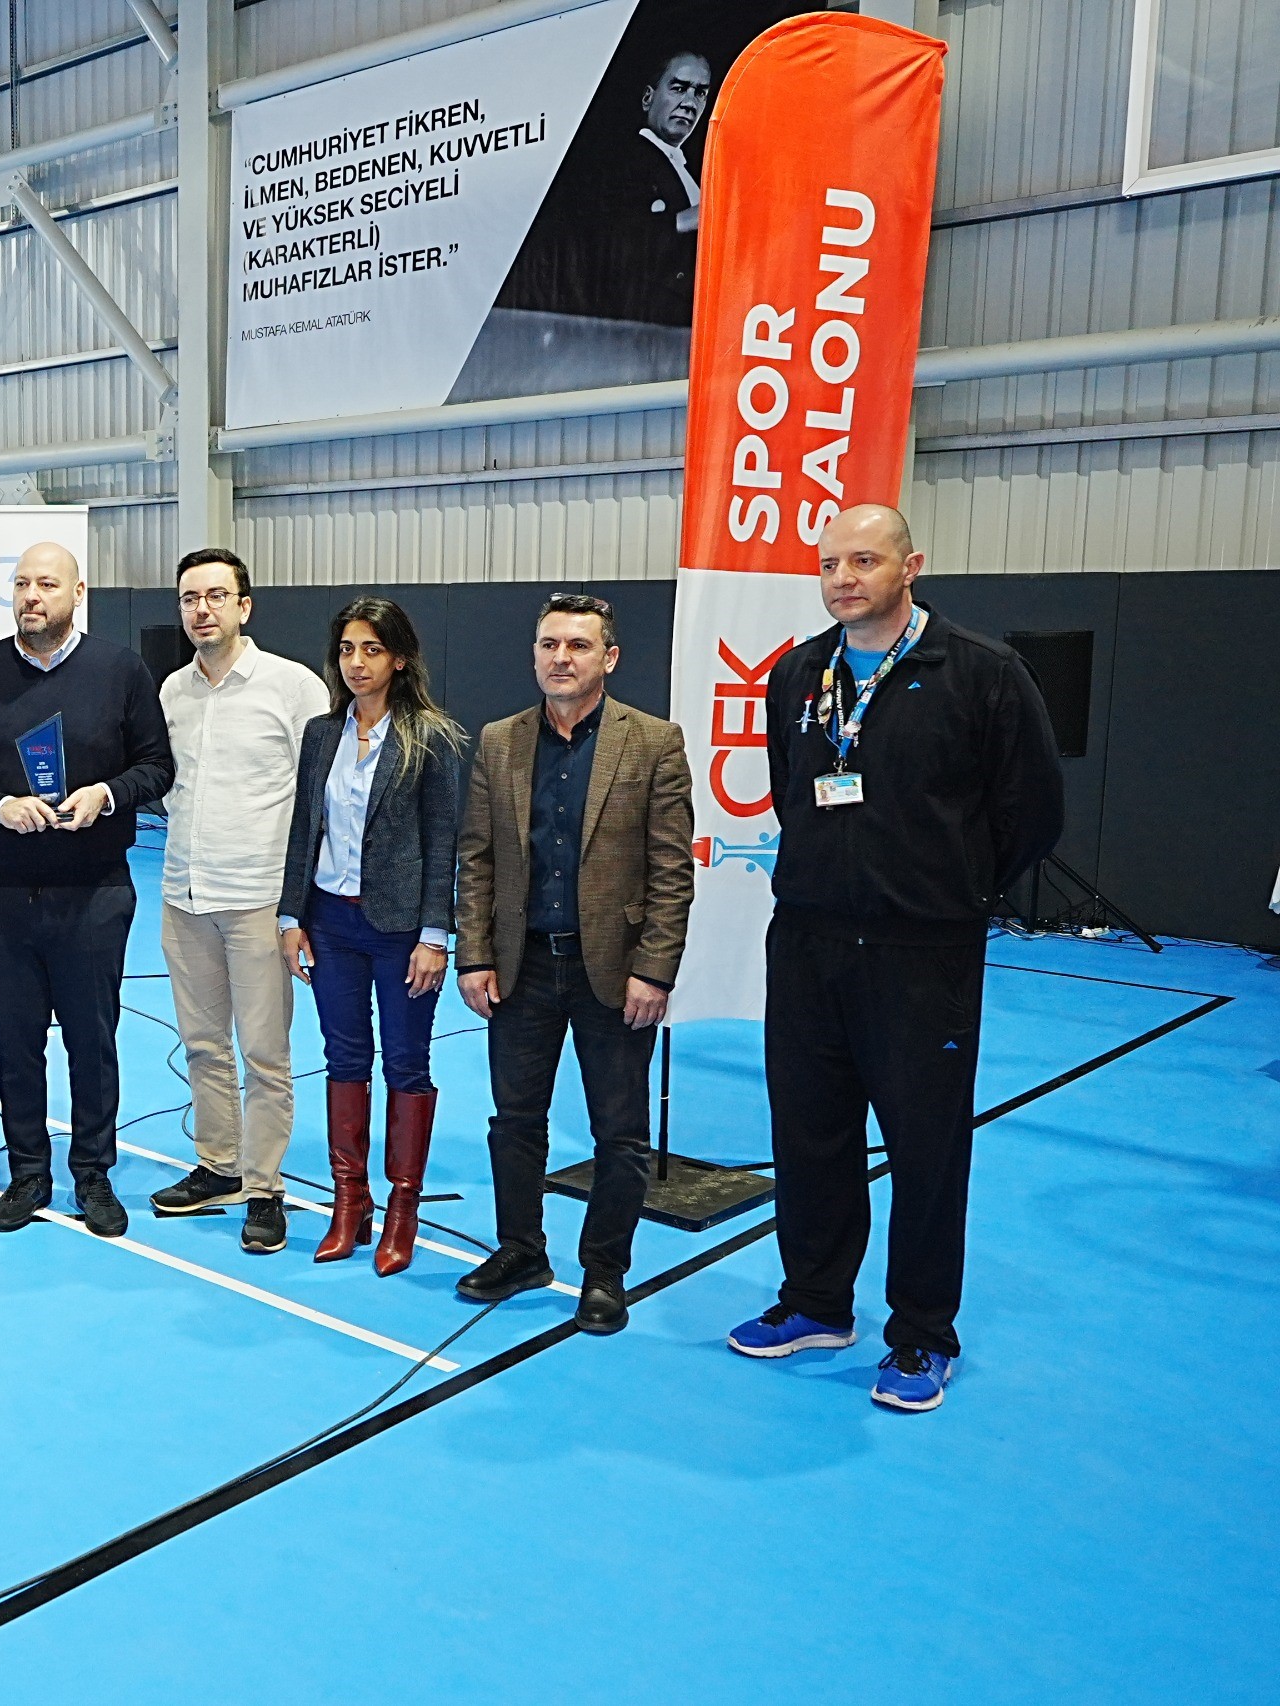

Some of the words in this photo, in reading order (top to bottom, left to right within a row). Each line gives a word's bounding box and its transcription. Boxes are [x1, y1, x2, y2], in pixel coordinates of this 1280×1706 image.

[244, 121, 389, 175] “CUMHURİYET
[395, 98, 486, 140] FİKREN,
[244, 176, 309, 209] İLMEN,
[315, 148, 423, 193] BEDENEN,
[429, 112, 546, 166] KUVVETLİ
[242, 216, 267, 240] VE
[271, 196, 355, 234] YÜKSEK
[359, 167, 459, 215] SECİYELİ
[242, 259, 372, 302] MUHAFIZLAR
[378, 243, 459, 278] İSTER.”
[243, 220, 380, 275] (KARAKTERLİ)
[241, 324, 288, 341] MUSTAFA
[288, 318, 324, 334] KEMAL
[324, 310, 371, 329] ATATÜRK
[796, 187, 876, 547] SALONU
[728, 303, 796, 545] SPOR
